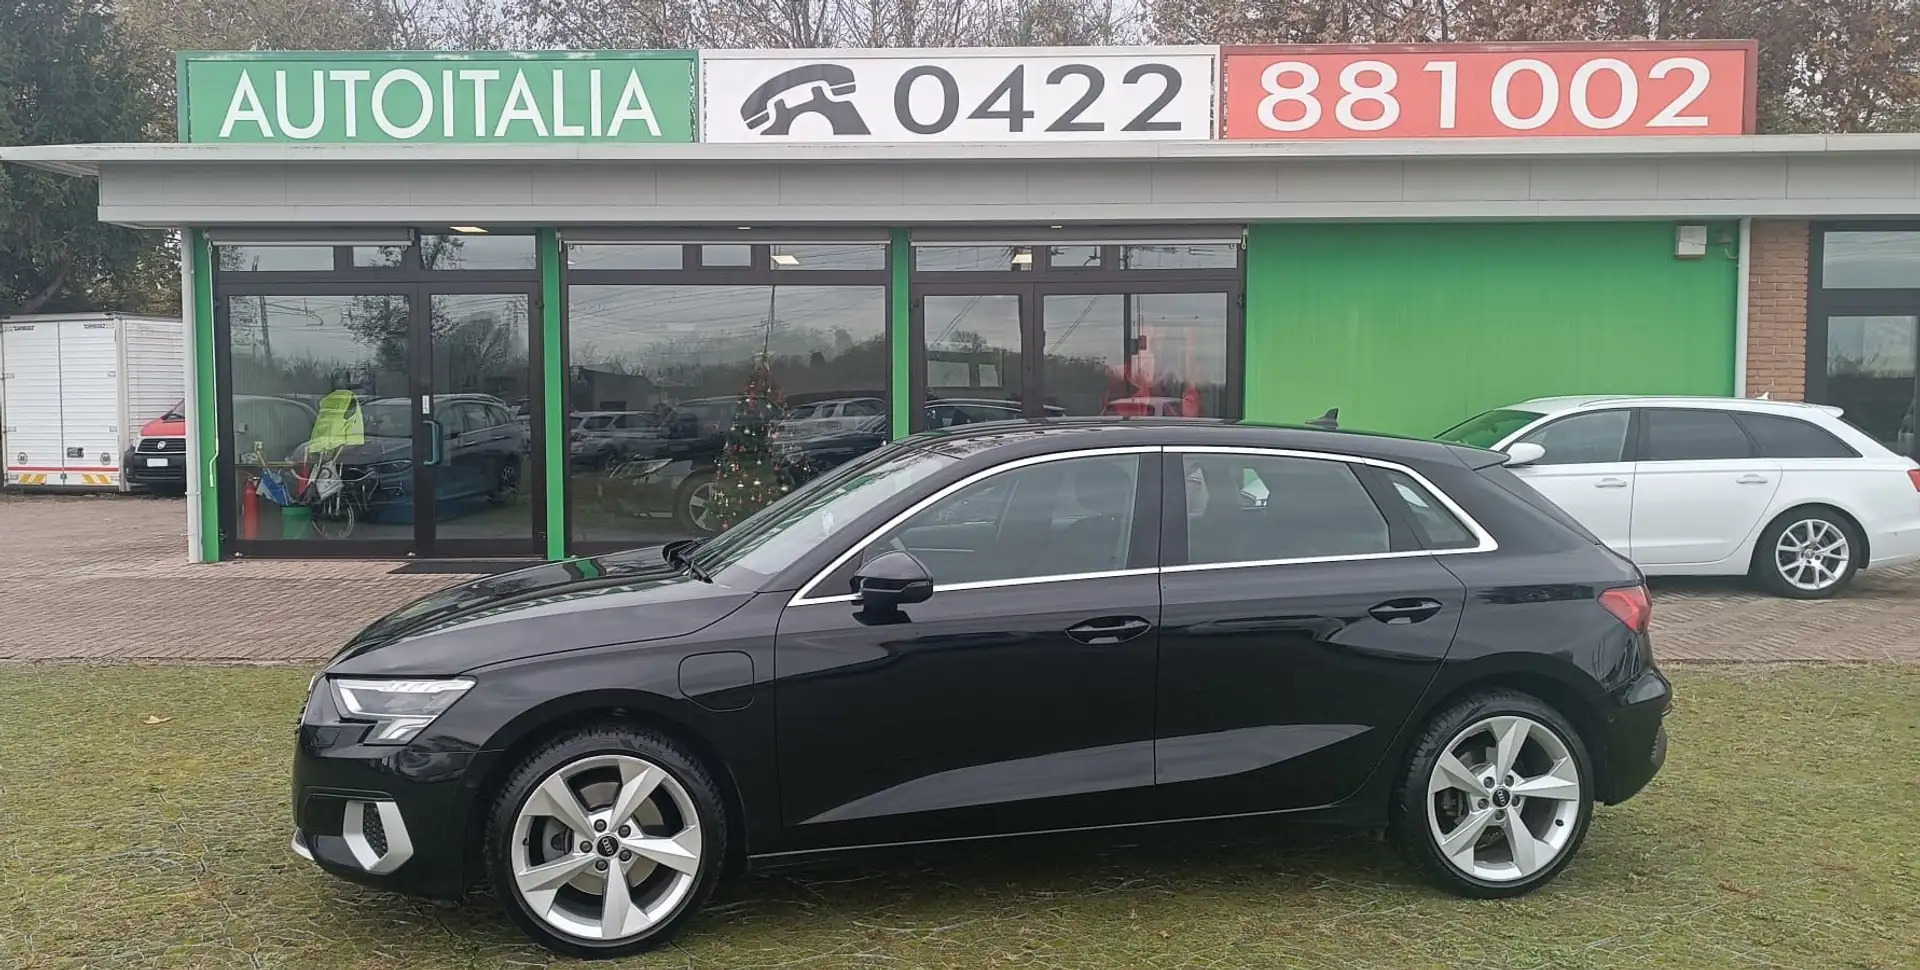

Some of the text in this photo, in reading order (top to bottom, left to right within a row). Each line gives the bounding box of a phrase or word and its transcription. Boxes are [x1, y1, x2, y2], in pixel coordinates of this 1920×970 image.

[219, 67, 662, 139] AUTOITALIA
[893, 63, 1182, 134] 0422
[1257, 57, 1711, 132] 881002
